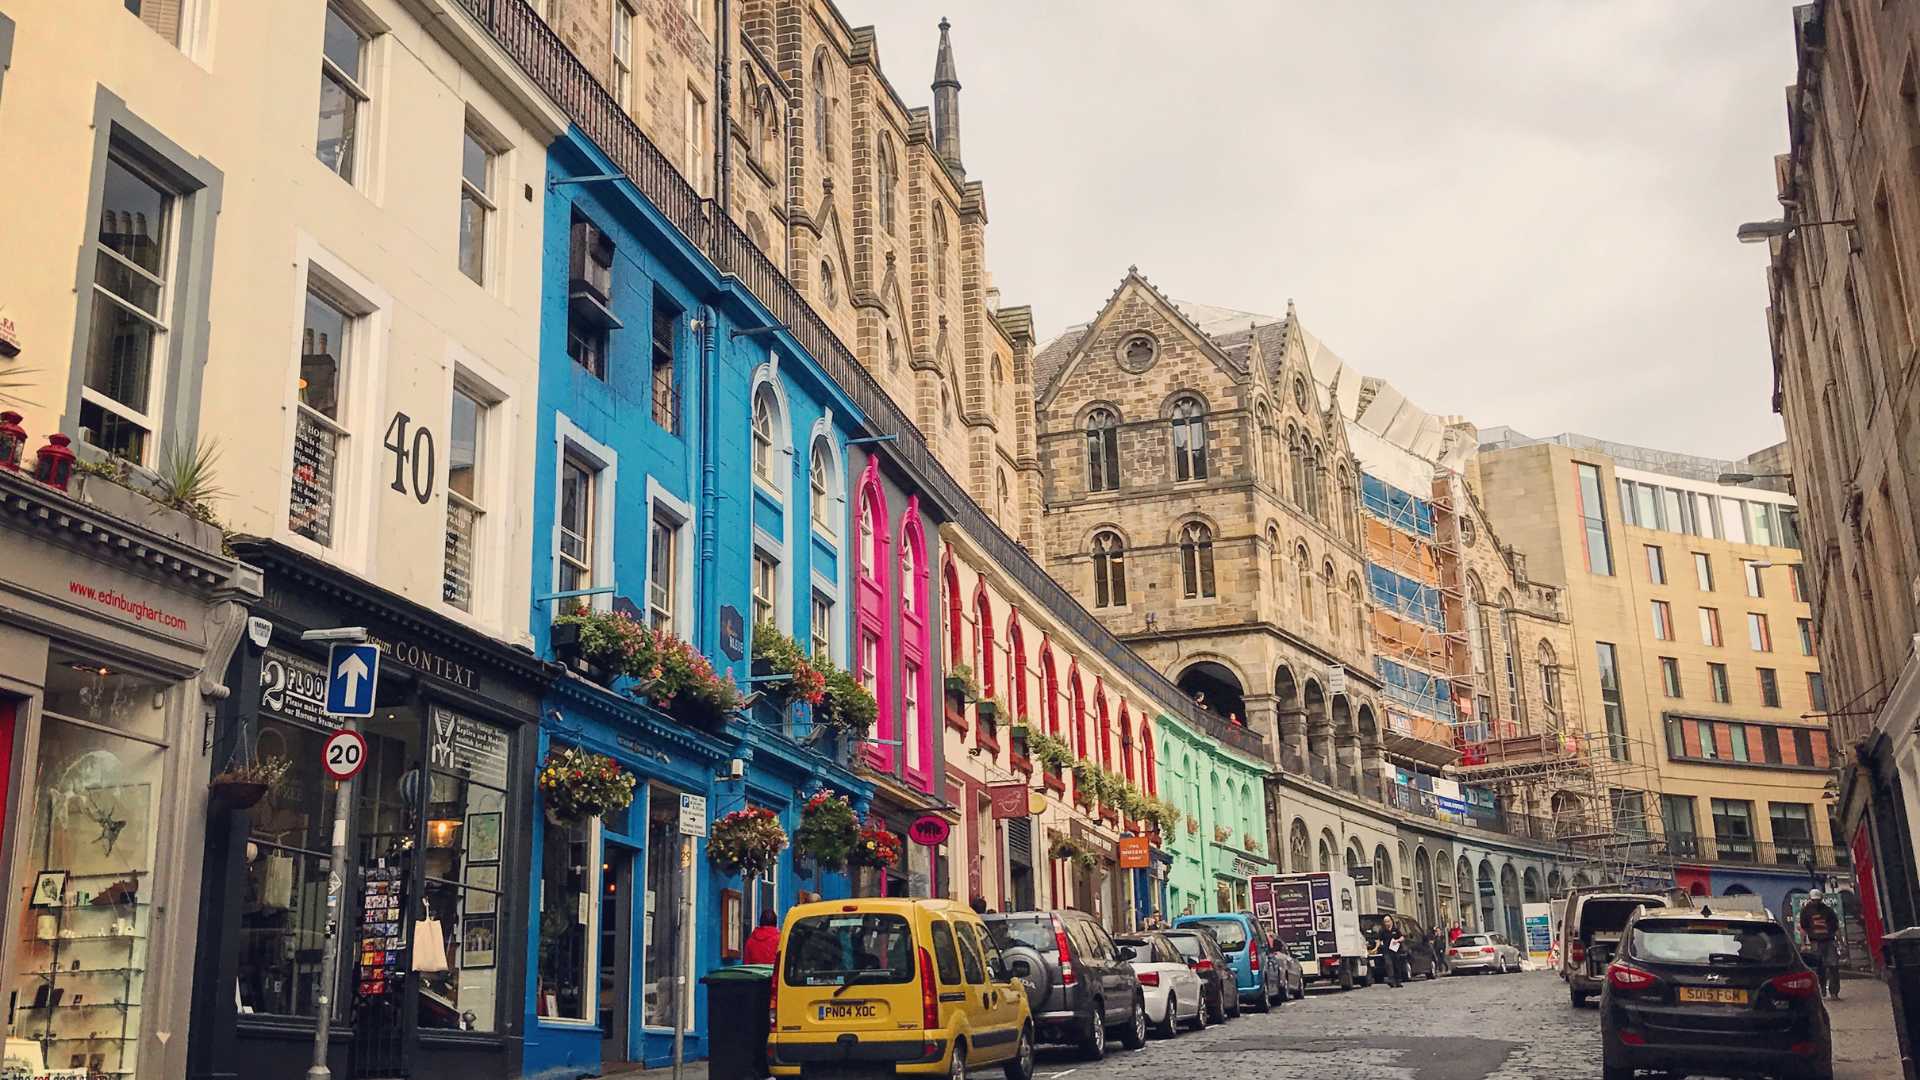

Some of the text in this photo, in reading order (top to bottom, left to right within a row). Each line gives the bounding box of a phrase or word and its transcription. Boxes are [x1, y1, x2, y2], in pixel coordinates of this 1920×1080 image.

[384, 411, 434, 504] 40
[69, 580, 187, 631] www.edinburghart.com
[396, 640, 475, 688] CONTEXT
[329, 744, 360, 764] 20
